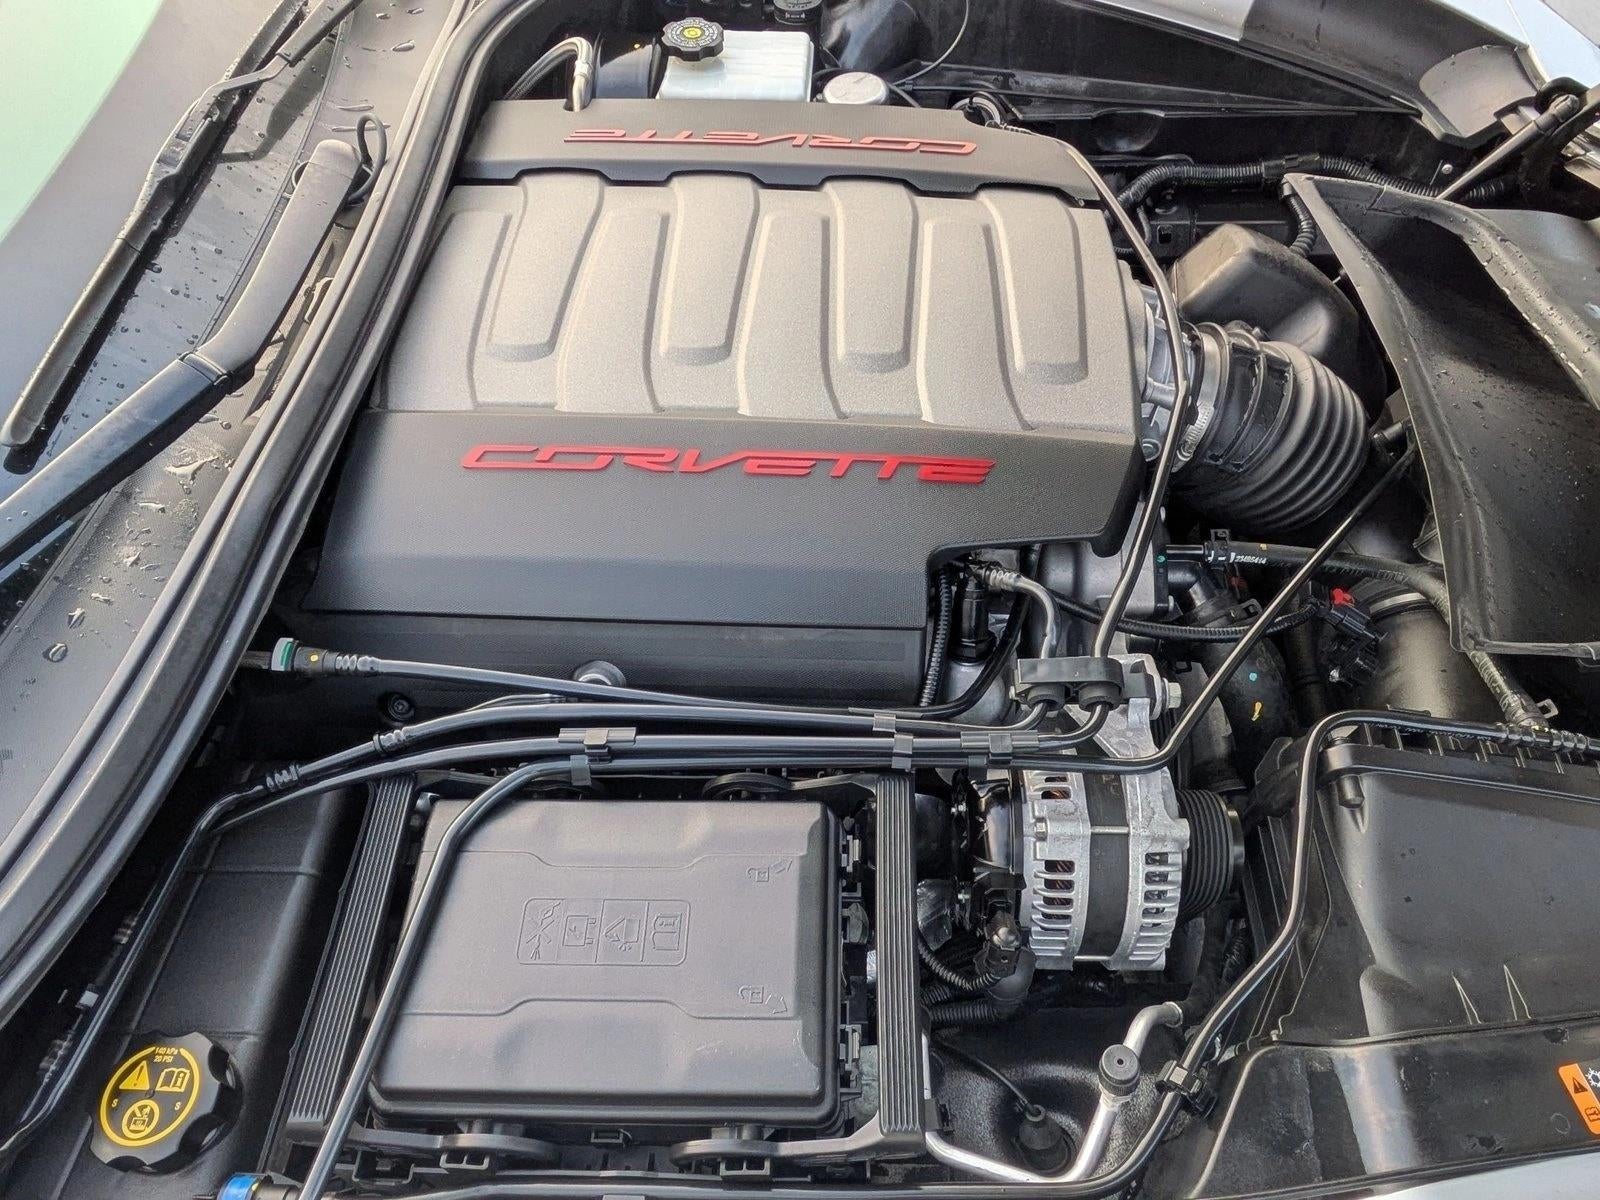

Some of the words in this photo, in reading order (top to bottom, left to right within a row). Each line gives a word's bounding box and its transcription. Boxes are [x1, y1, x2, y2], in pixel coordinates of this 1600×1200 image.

[564, 129, 977, 155] CORVETTE
[461, 444, 996, 484] CORVETTE
[155, 1047, 166, 1055] 140
